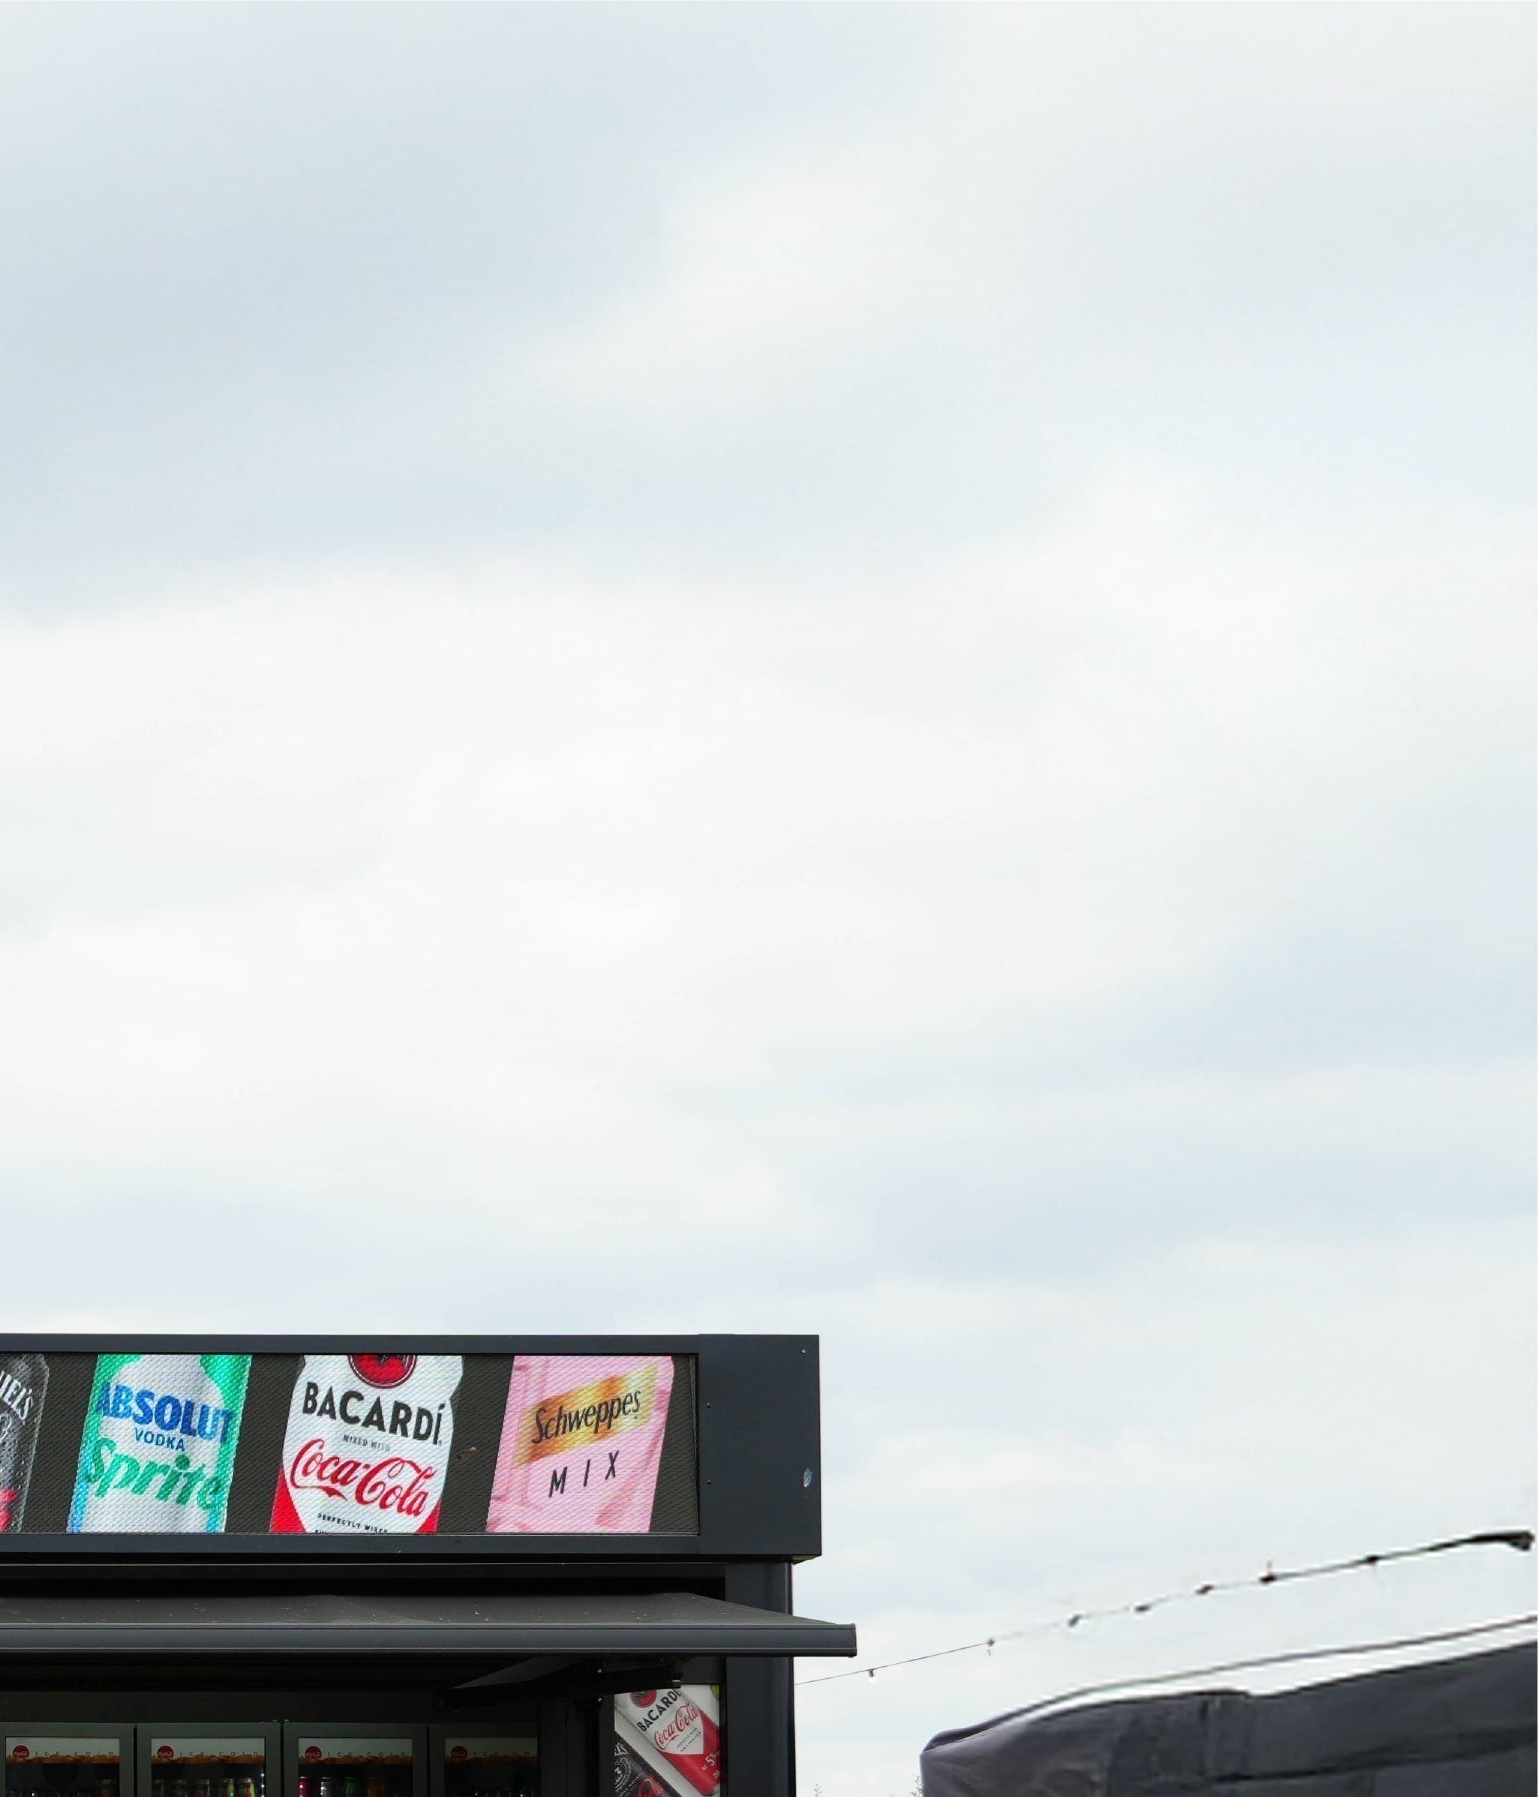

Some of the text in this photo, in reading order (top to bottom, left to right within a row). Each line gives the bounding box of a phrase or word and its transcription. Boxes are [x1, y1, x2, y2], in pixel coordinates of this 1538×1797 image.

[96, 1383, 234, 1443] ABSOLUT
[134, 1427, 186, 1452] VODKA
[531, 1390, 642, 1445] Schweppes
[84, 1438, 222, 1511] Sprite
[290, 1439, 437, 1517] Coca-Cola
[548, 1450, 619, 1498] MIX
[653, 1700, 699, 1751] Coca-Cola
